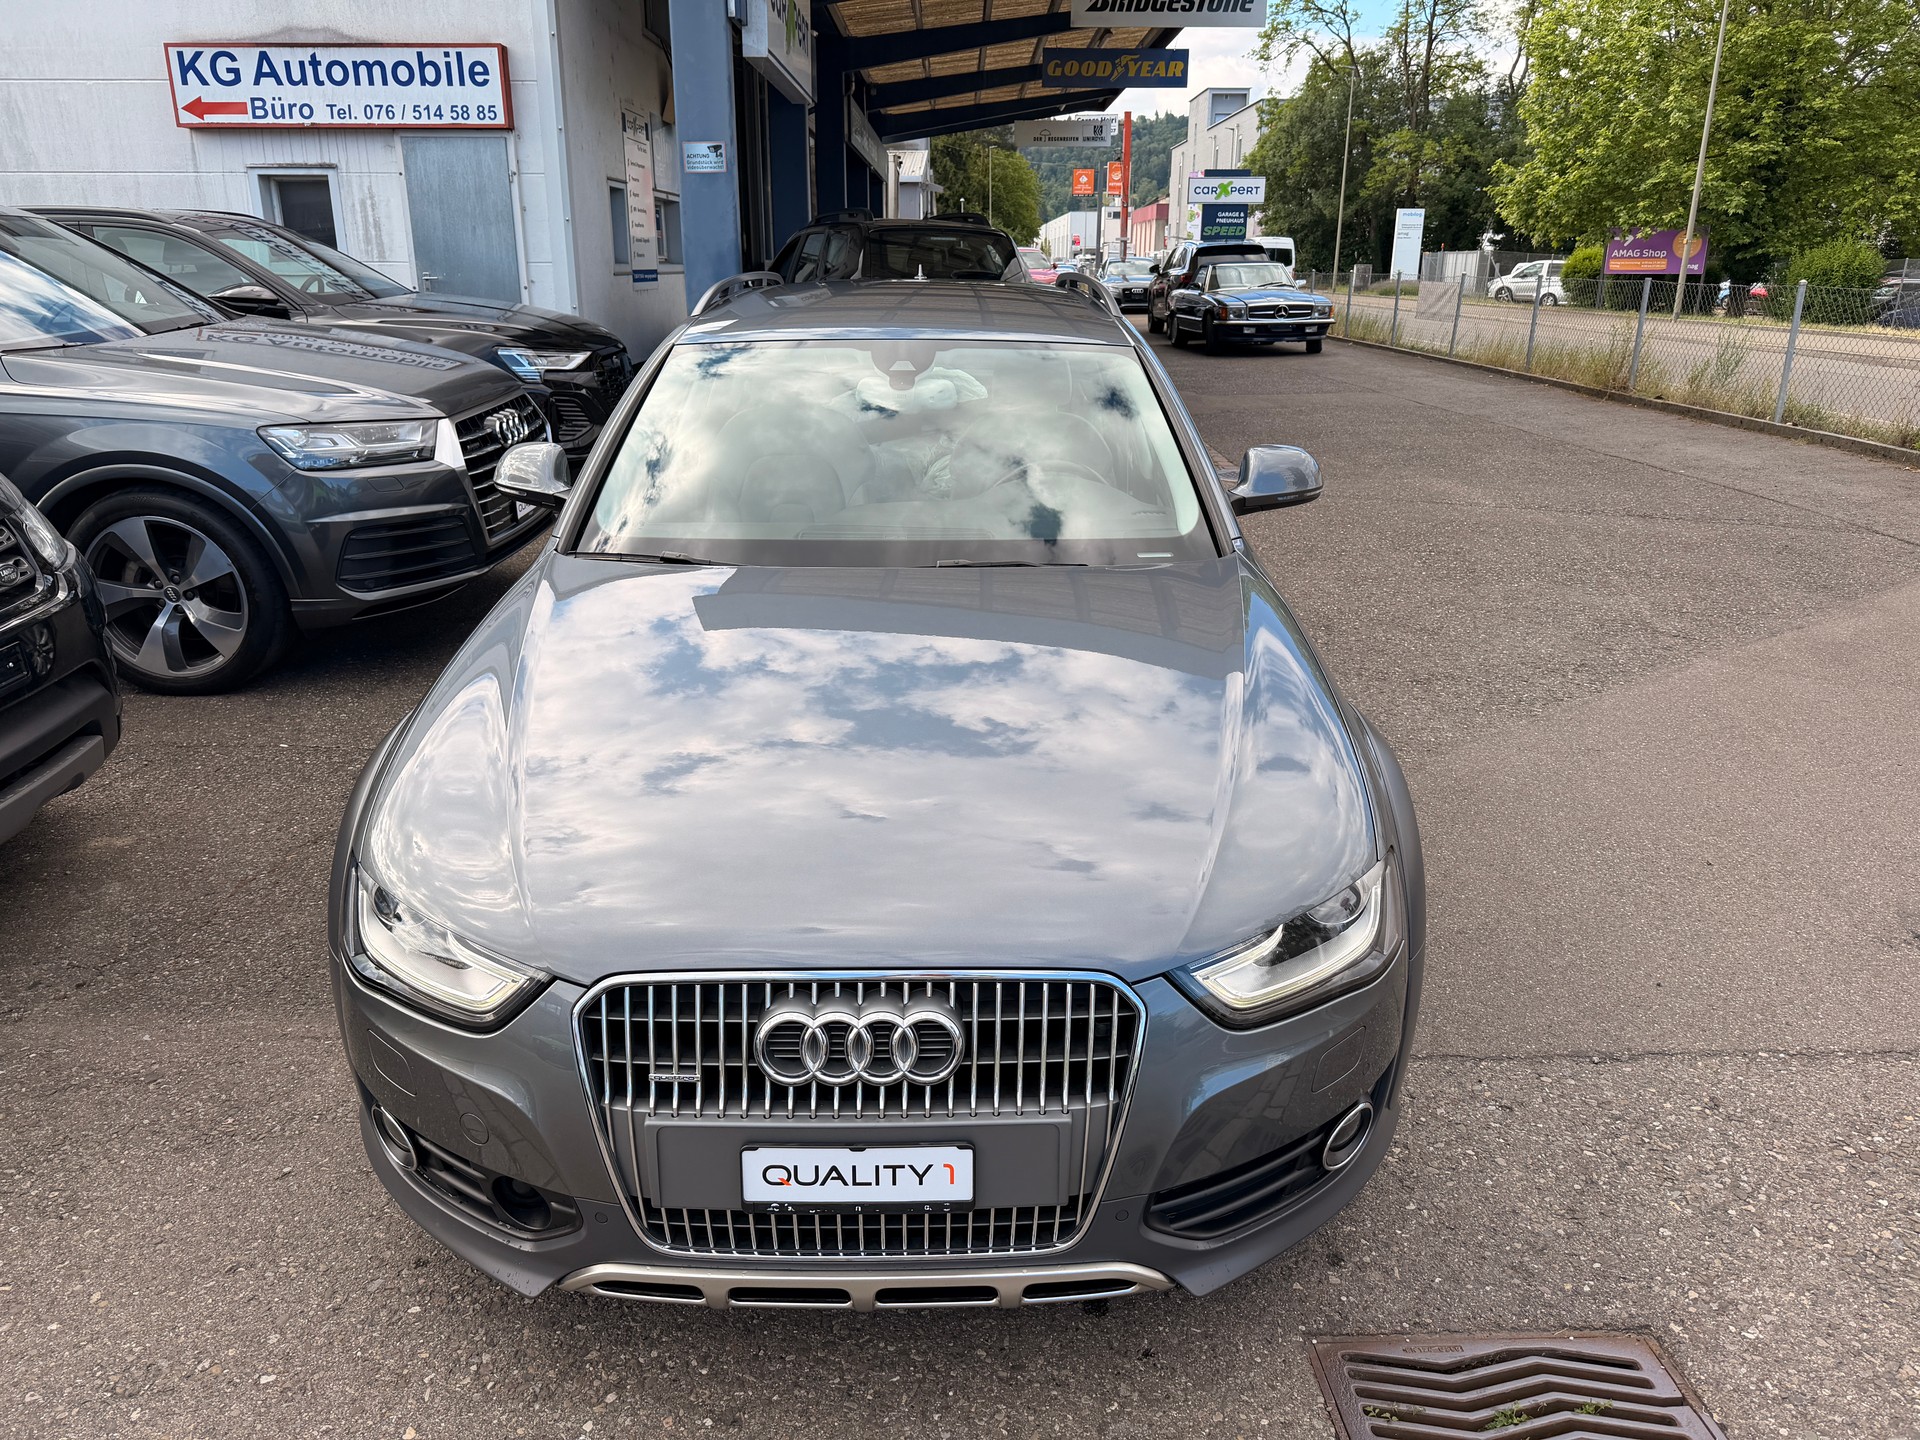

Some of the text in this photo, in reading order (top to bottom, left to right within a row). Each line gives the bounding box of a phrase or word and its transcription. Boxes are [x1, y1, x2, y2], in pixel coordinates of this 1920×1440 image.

[176, 50, 490, 87] KG Automobile
[249, 96, 498, 121] Büro Tel. 076 / 514 58 85
[1202, 225, 1247, 236] SPEED
[1611, 248, 1667, 259] AMAG Shop
[761, 1163, 955, 1187] QUALITY 1
